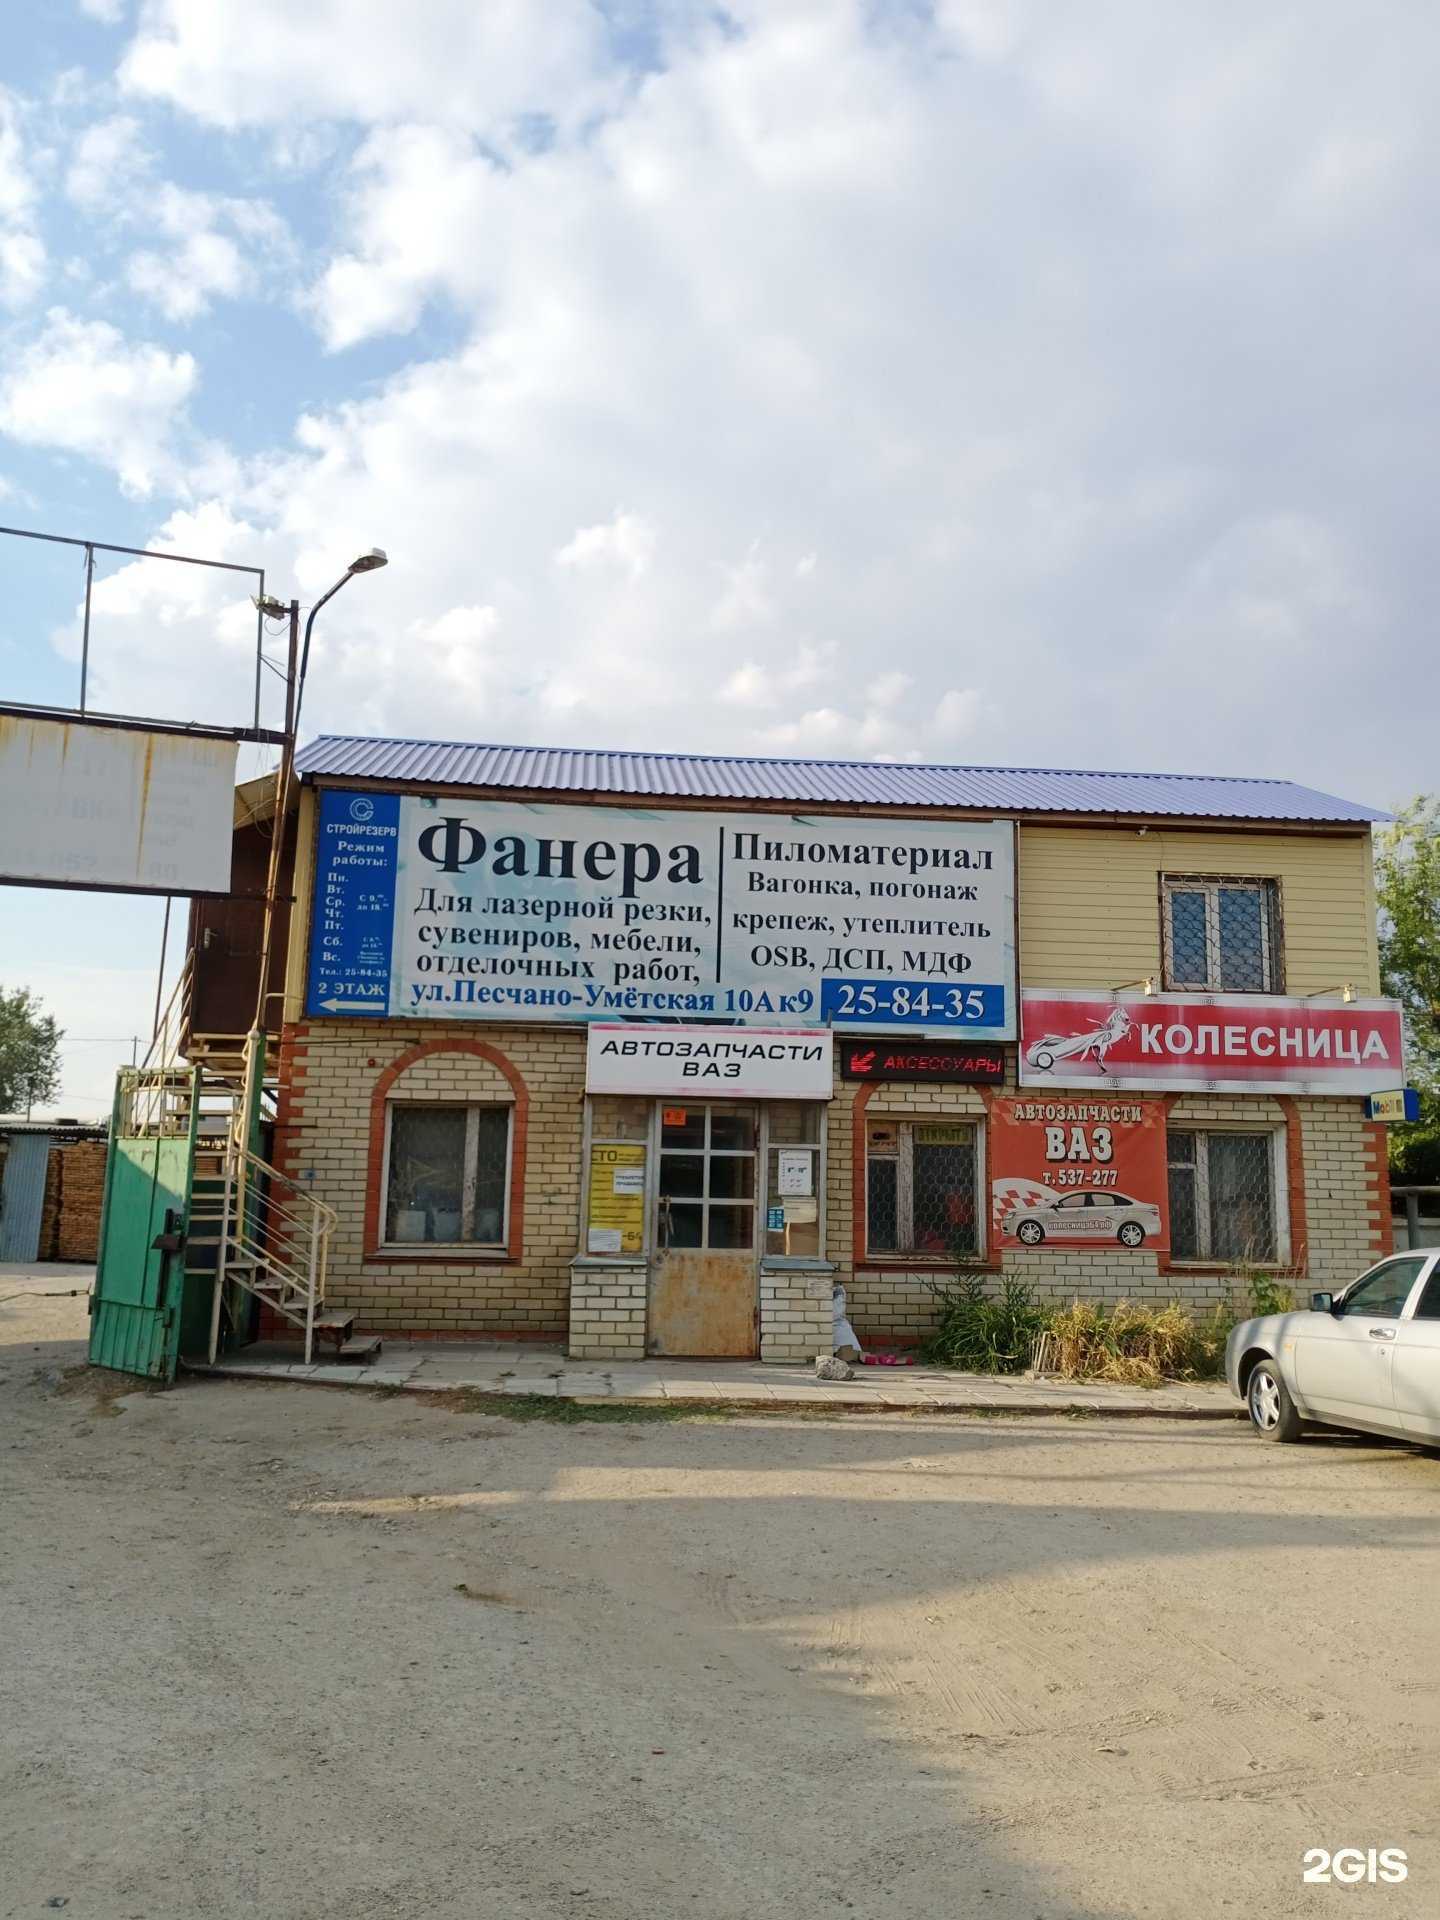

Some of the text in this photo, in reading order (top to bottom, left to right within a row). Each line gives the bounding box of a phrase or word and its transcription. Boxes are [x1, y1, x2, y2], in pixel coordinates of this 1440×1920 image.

[326, 823, 397, 837] СТРОЙРЕЗЕРВ
[337, 841, 385, 853] Режим
[732, 832, 994, 875] Пиломатериал
[332, 855, 388, 867] работы:
[417, 816, 704, 899] Фанера
[326, 884, 345, 895] Вт.
[747, 871, 978, 901] Вагонка, погонаж
[325, 896, 345, 908] Ср.
[413, 887, 712, 928] Для лазерной резки,
[324, 908, 344, 918] Чт.
[324, 920, 344, 931] Пт.
[732, 912, 991, 938] крепеж, утеплитель
[322, 936, 343, 946] Сб.
[417, 925, 702, 957] сувениров, мебели,
[322, 951, 341, 961] Вс.
[750, 944, 972, 977] OSB, ДСП, МДФ
[416, 954, 596, 978] отделочных
[613, 958, 700, 986] работ,
[318, 983, 386, 996] 2 ЭТАЖ
[837, 983, 985, 1020] 25-84-35
[600, 1040, 824, 1061] АВТОЗАПЧАСТИ
[1140, 1023, 1391, 1065] КОЛЕСНИЦА
[681, 1061, 742, 1078] ВАЗ
[882, 1056, 1002, 1074] АКСЕССУАРЫ
[1014, 1103, 1143, 1123] АВТОЗАПЧАСТИ
[1044, 1126, 1113, 1163] ВАЗ
